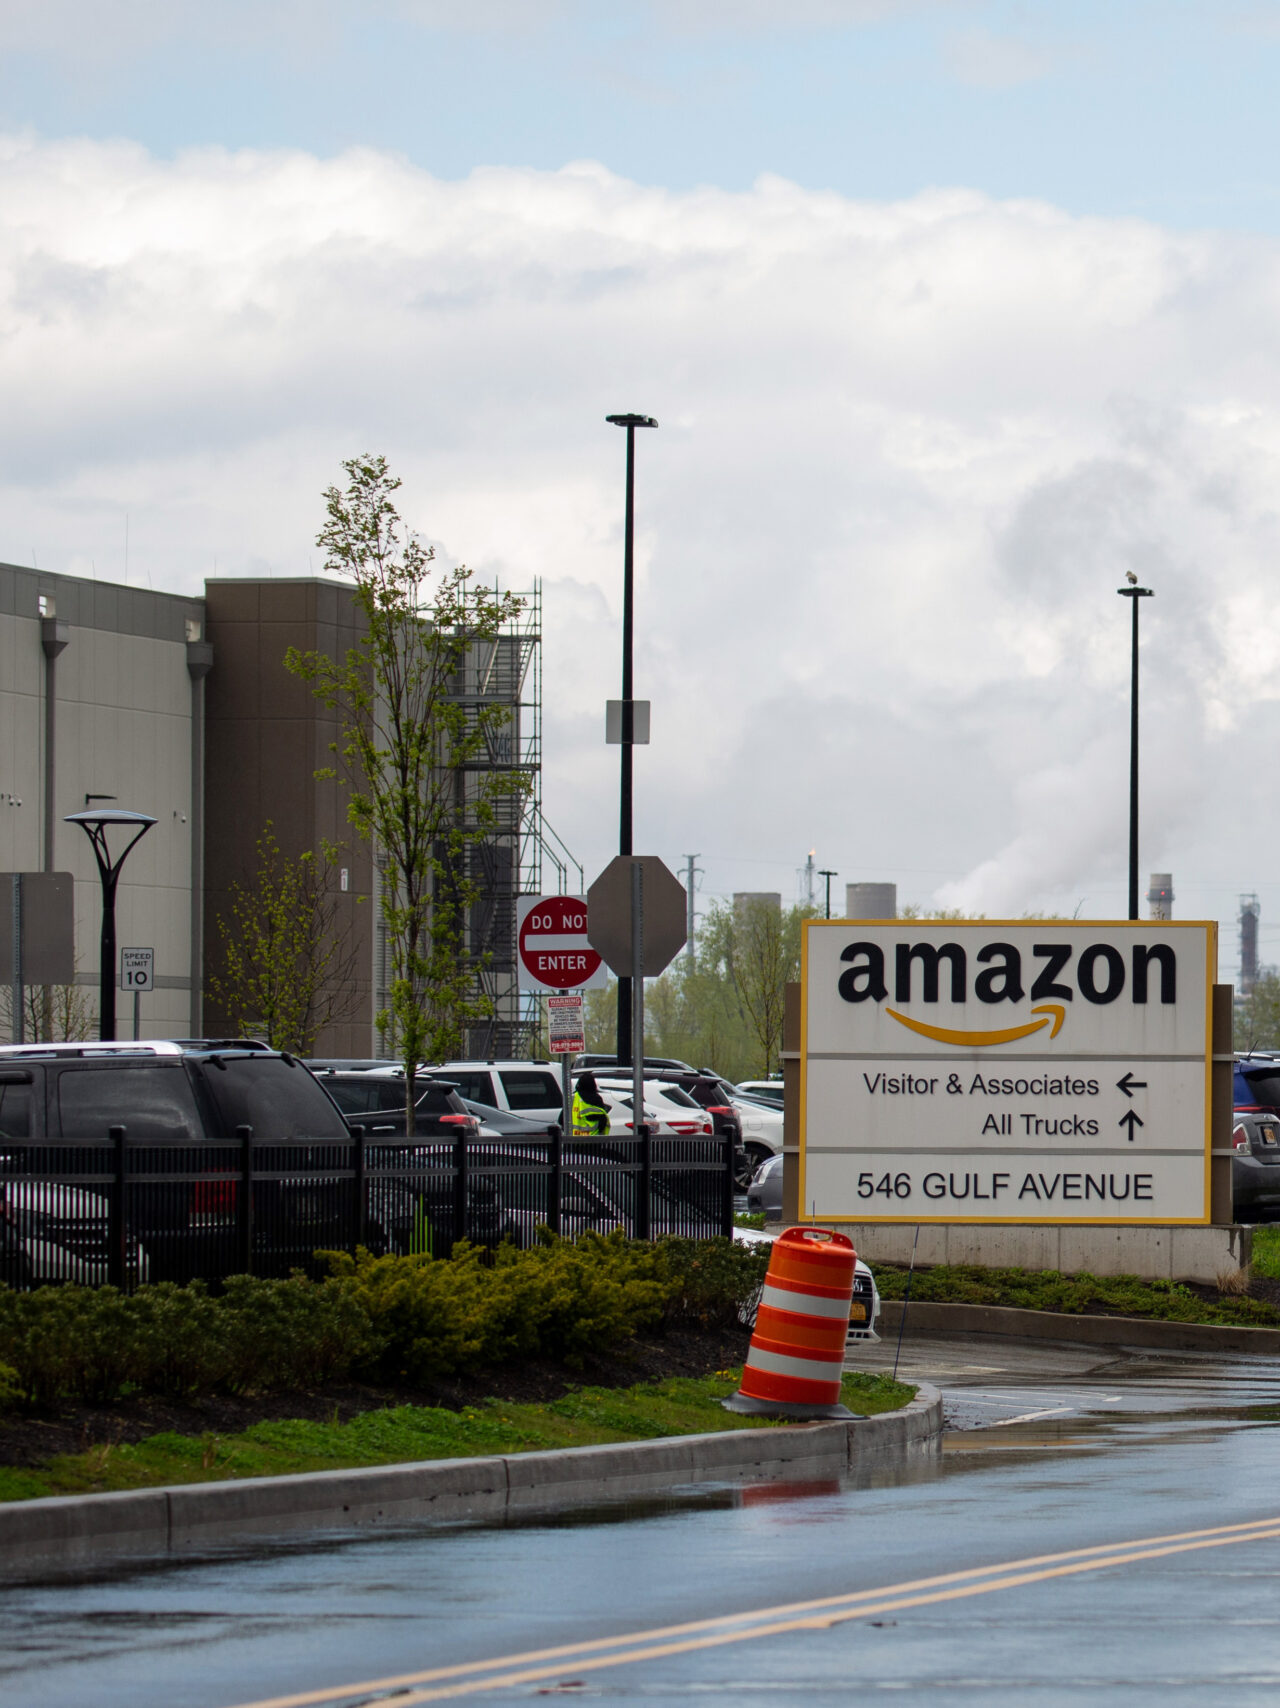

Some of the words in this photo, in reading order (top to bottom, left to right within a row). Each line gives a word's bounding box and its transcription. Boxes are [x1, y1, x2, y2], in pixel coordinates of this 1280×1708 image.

[532, 915, 552, 930] DO
[538, 956, 587, 970] ENTER
[837, 941, 1177, 1004] amazon
[126, 971, 147, 985] 10
[863, 1073, 938, 1095] Visitor
[946, 1073, 963, 1095] &
[969, 1073, 1100, 1096] Associates
[981, 1113, 1012, 1136] All
[1019, 1113, 1100, 1136] Trucks
[857, 1172, 912, 1199] 546
[922, 1172, 1011, 1200] GULF
[1018, 1173, 1154, 1200] AVENUE
